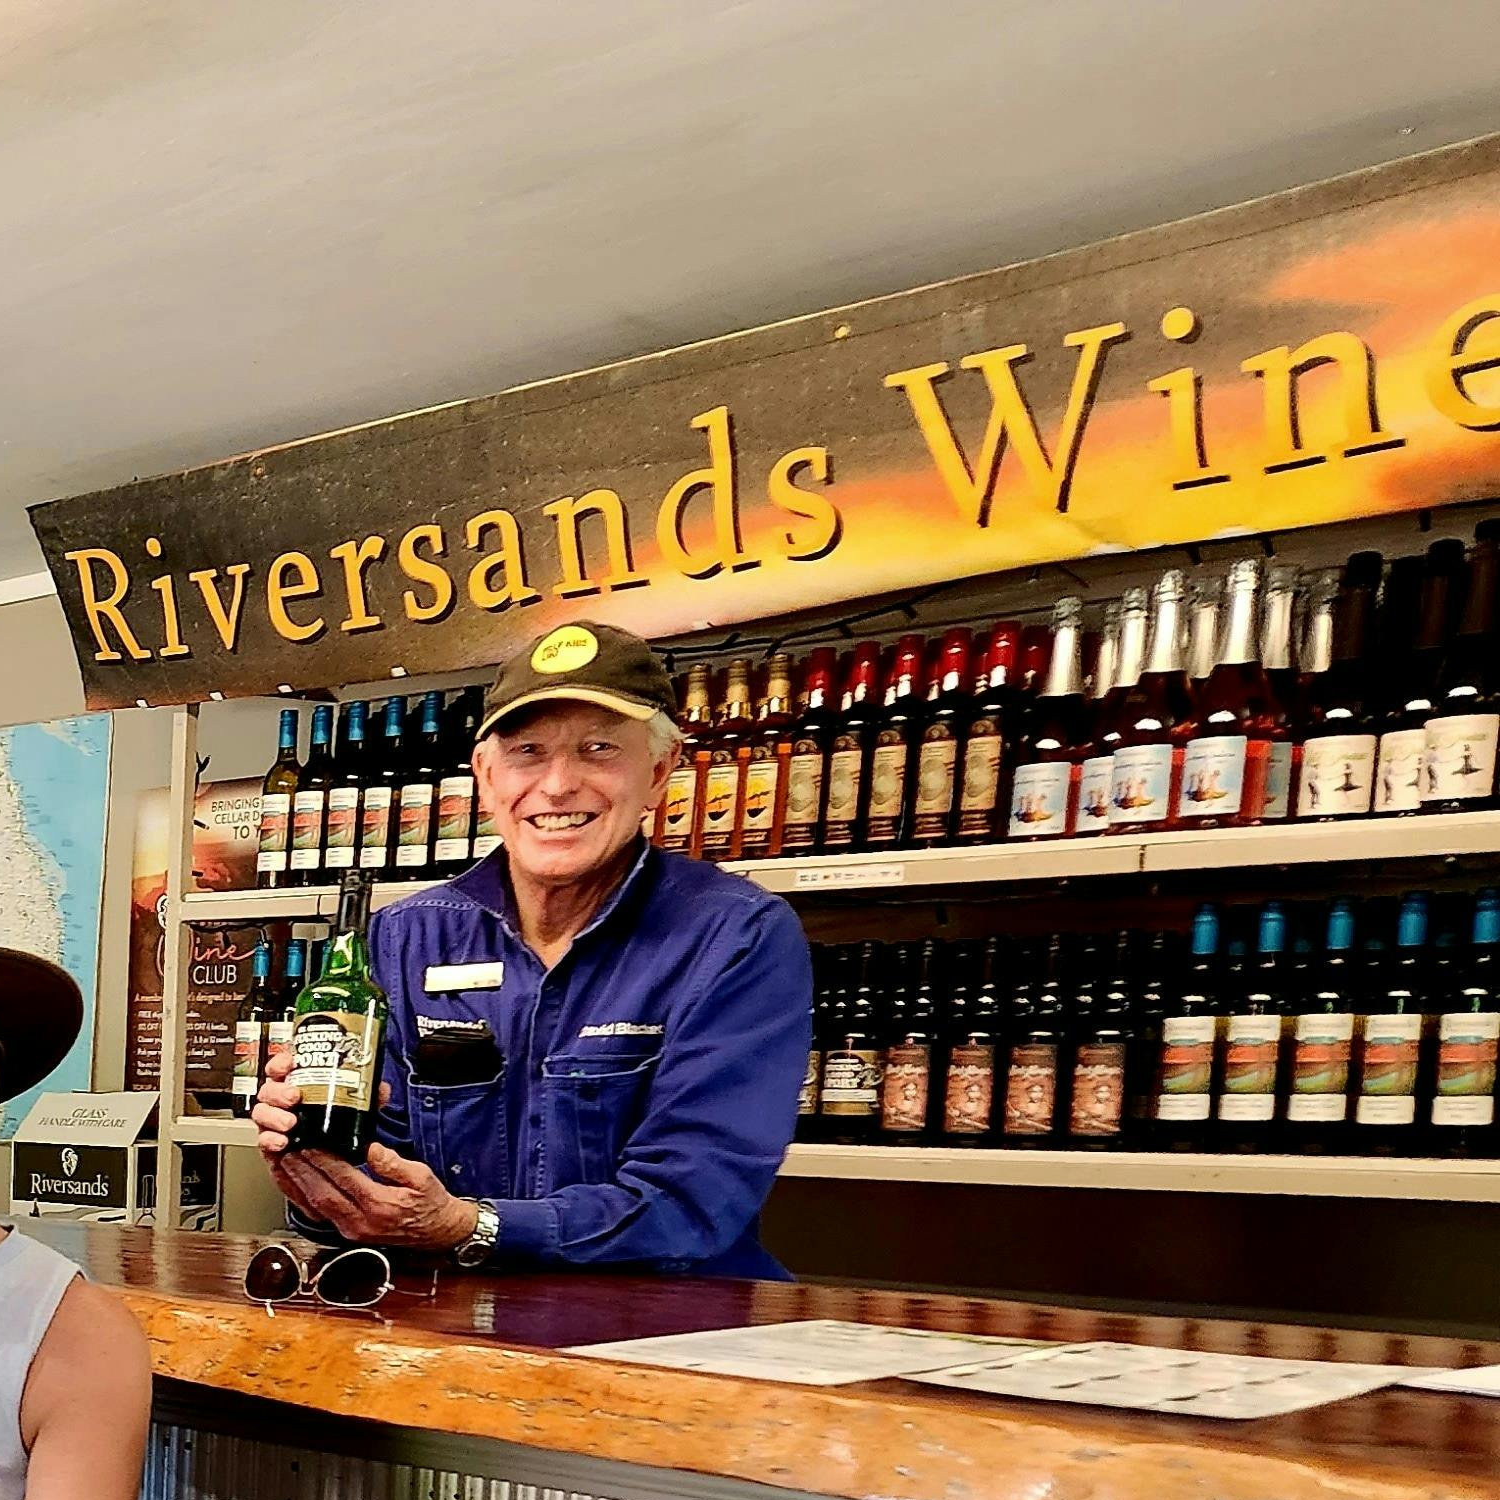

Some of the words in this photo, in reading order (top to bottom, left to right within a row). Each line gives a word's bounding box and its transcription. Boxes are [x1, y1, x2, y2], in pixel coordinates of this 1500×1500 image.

[64, 405, 845, 664] Riversands
[211, 797, 260, 812] BRINGING
[214, 811, 250, 825] CELLAR
[232, 825, 250, 840] TO
[192, 964, 238, 985] CLUB
[71, 1108, 109, 1119] GLASS
[38, 1117, 77, 1128] HANDLE
[78, 1119, 101, 1128] WITH
[102, 1119, 128, 1128] CARE
[29, 1172, 110, 1197] Riversands
